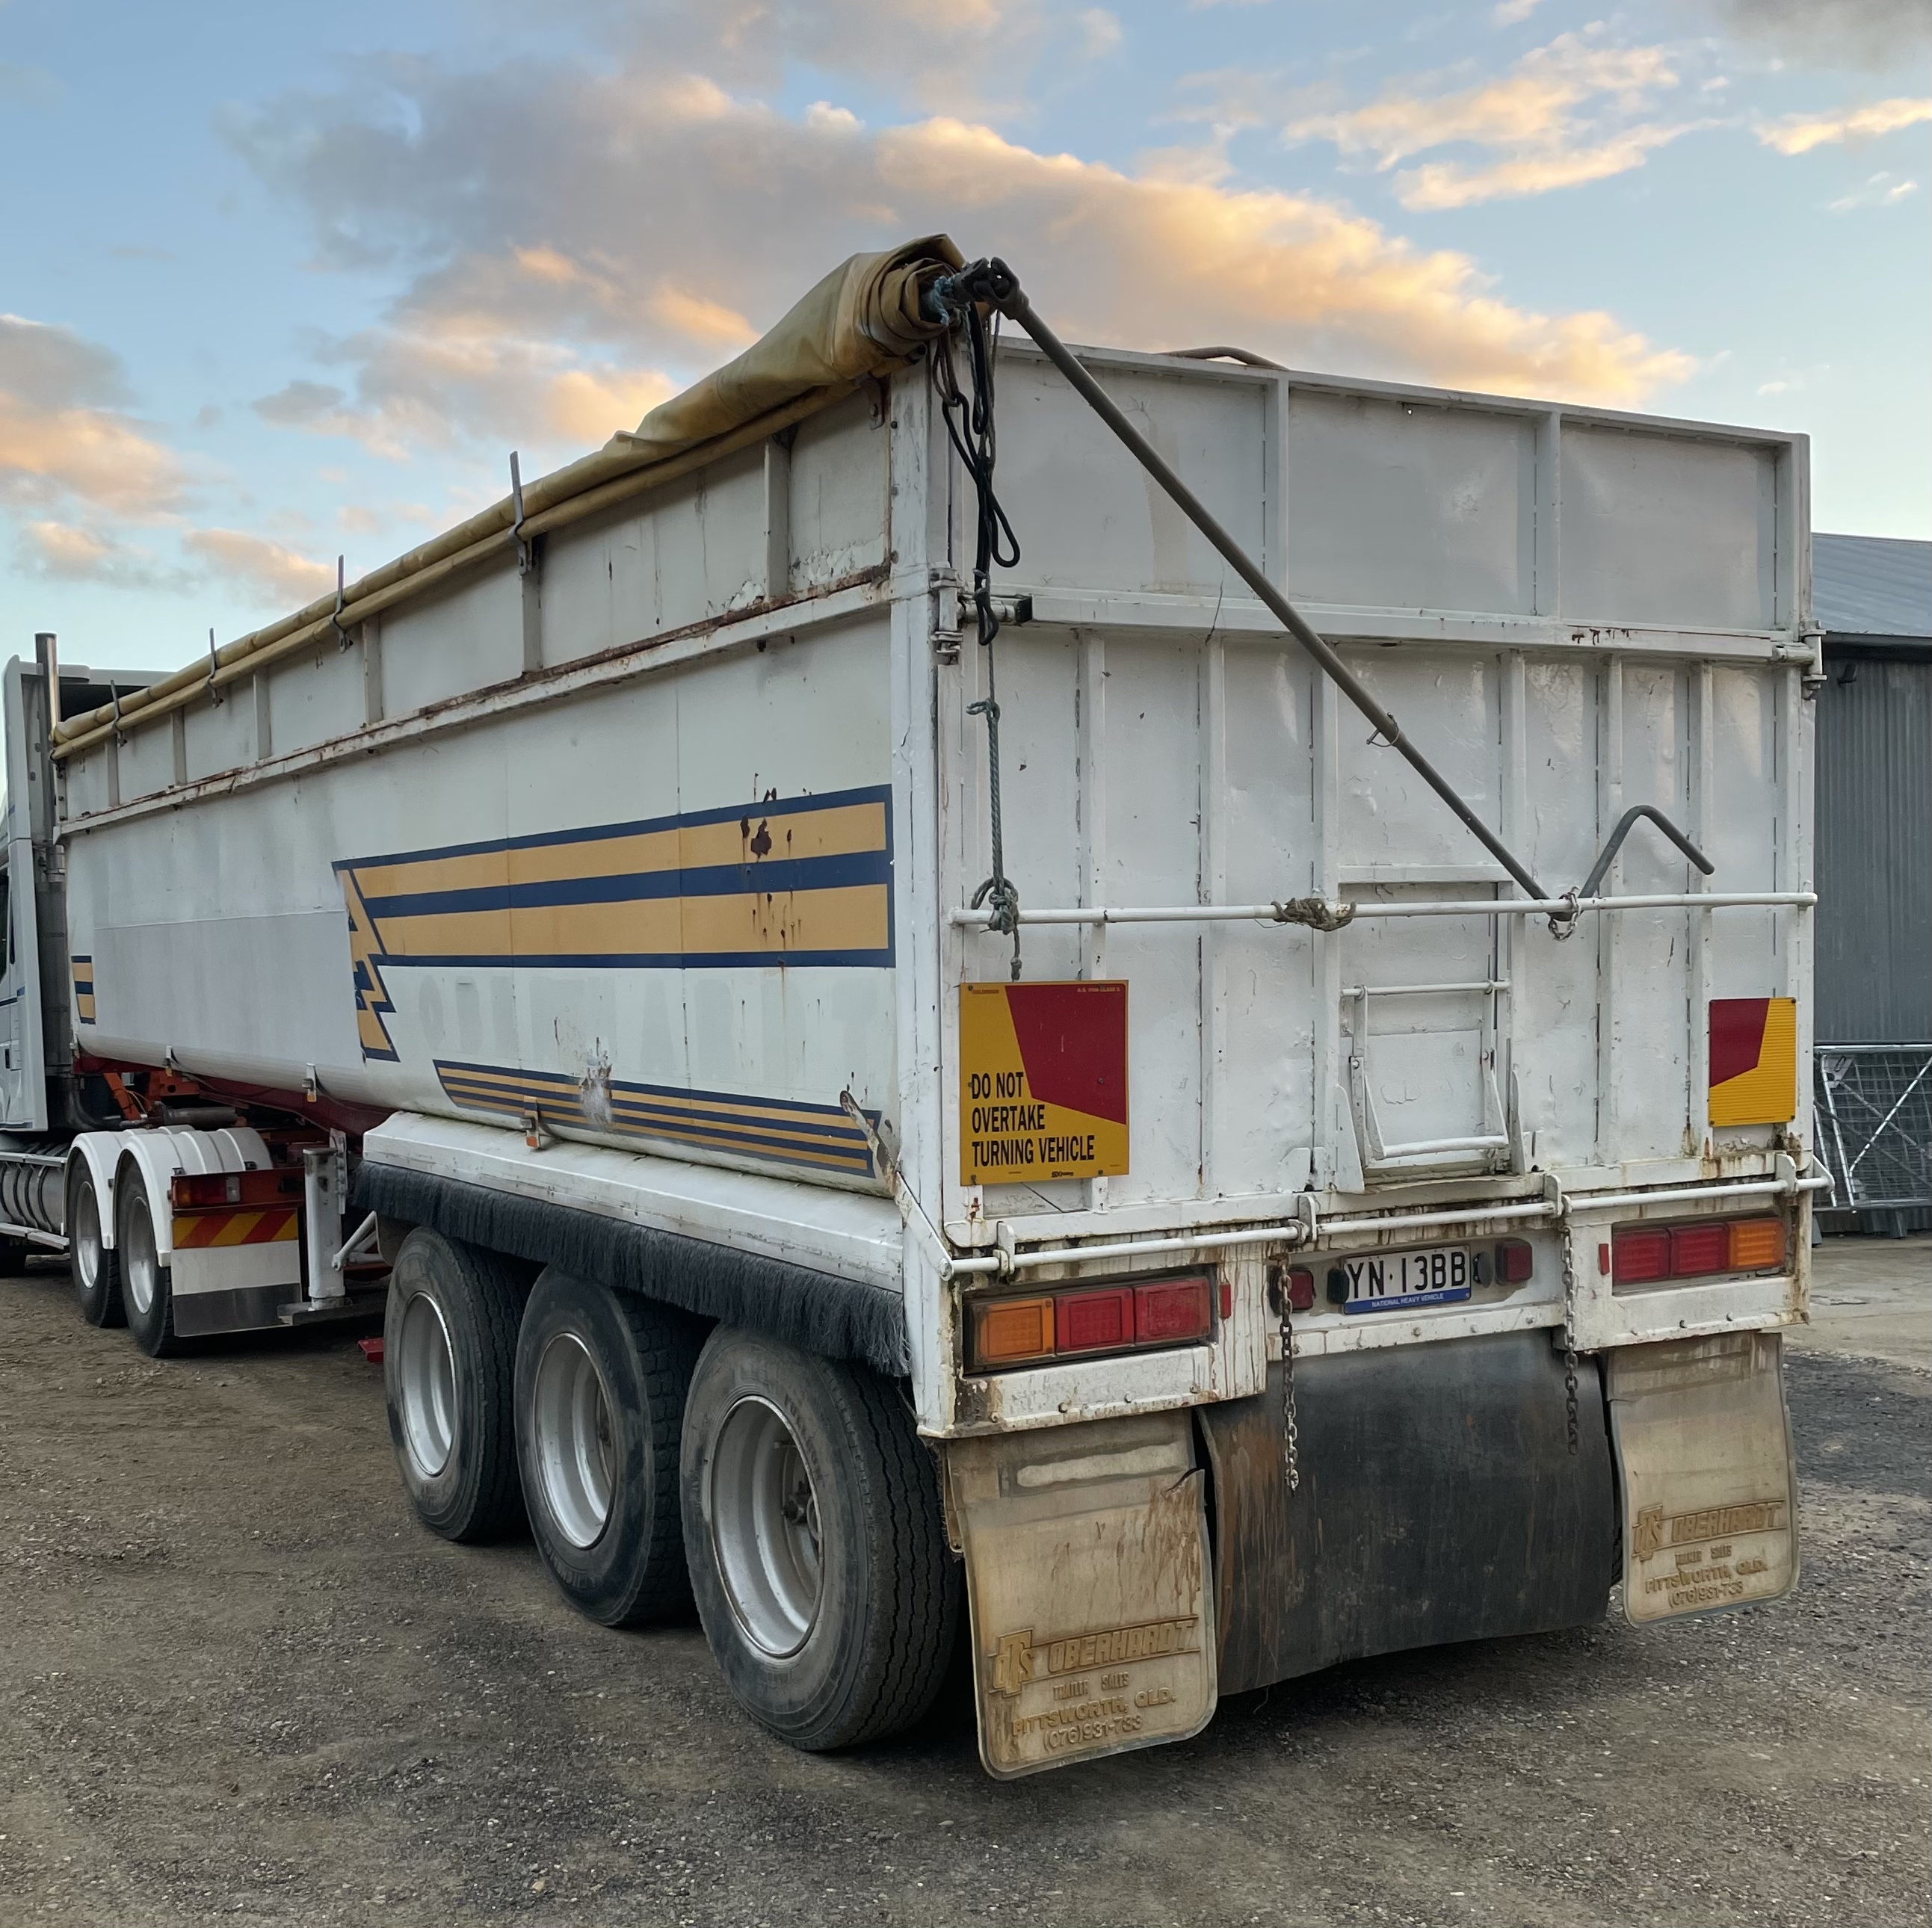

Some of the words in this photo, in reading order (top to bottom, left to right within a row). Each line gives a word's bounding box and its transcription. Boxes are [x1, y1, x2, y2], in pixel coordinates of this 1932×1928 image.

[972, 1073, 991, 1099] DO
[996, 1072, 1024, 1099] NOT
[972, 1104, 1046, 1133] OVERTAKE
[972, 1138, 1034, 1167] TURNING
[1038, 1135, 1095, 1163] VEHICLE
[1371, 1297, 1400, 1308] NATIONAL
[1401, 1294, 1421, 1305] HEAVY
[1421, 1292, 1444, 1303] VEHICLE
[1049, 1620, 1196, 1673] OBERHARDT
